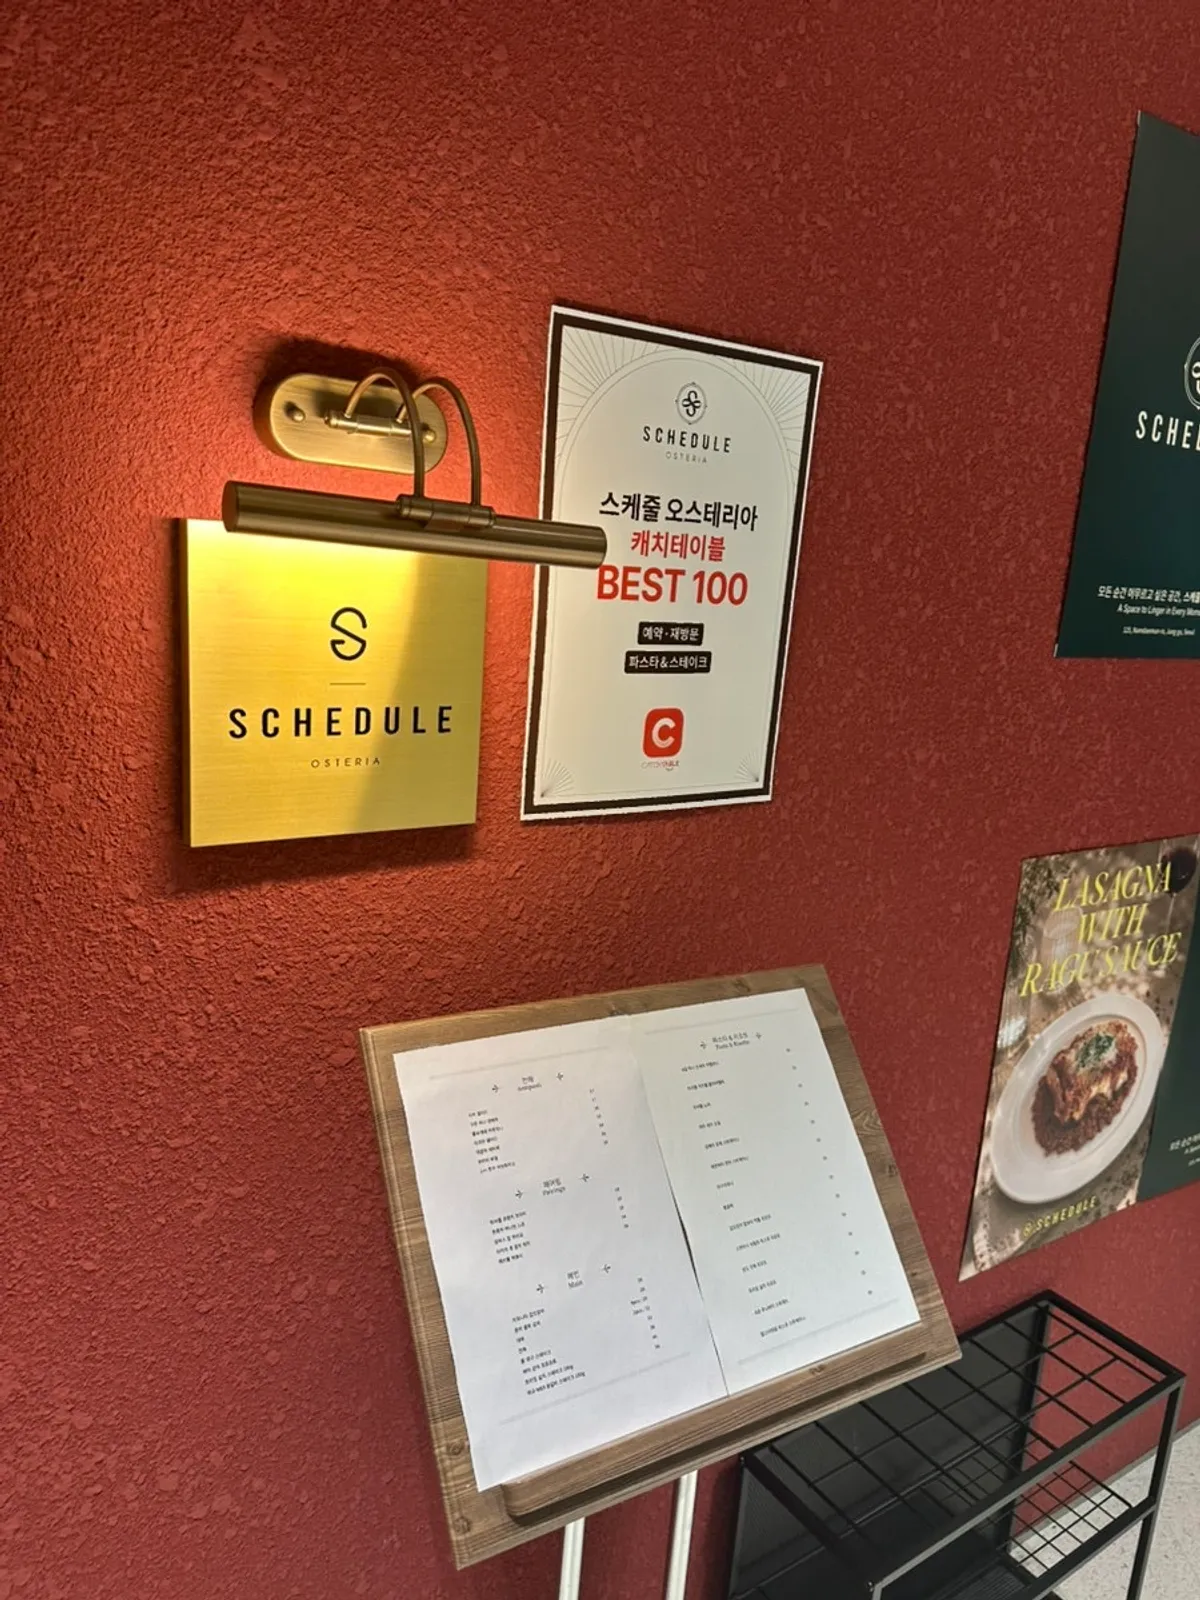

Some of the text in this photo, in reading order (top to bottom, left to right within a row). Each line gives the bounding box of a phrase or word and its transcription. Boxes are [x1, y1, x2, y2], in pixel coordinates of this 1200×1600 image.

[643, 425, 731, 453] SCHEDULE
[665, 450, 708, 464] OSTERIA
[599, 491, 759, 531] 스케줄 오스테리아
[631, 529, 726, 562] 캐치테이블
[597, 564, 748, 606] BEST 100
[229, 706, 452, 739] SCHEDULE
[311, 756, 381, 769] OSTERIA
[1052, 861, 1171, 912] LASAGNA
[1079, 903, 1149, 944] WITH
[1019, 932, 1182, 997] RAGU SAUCE
